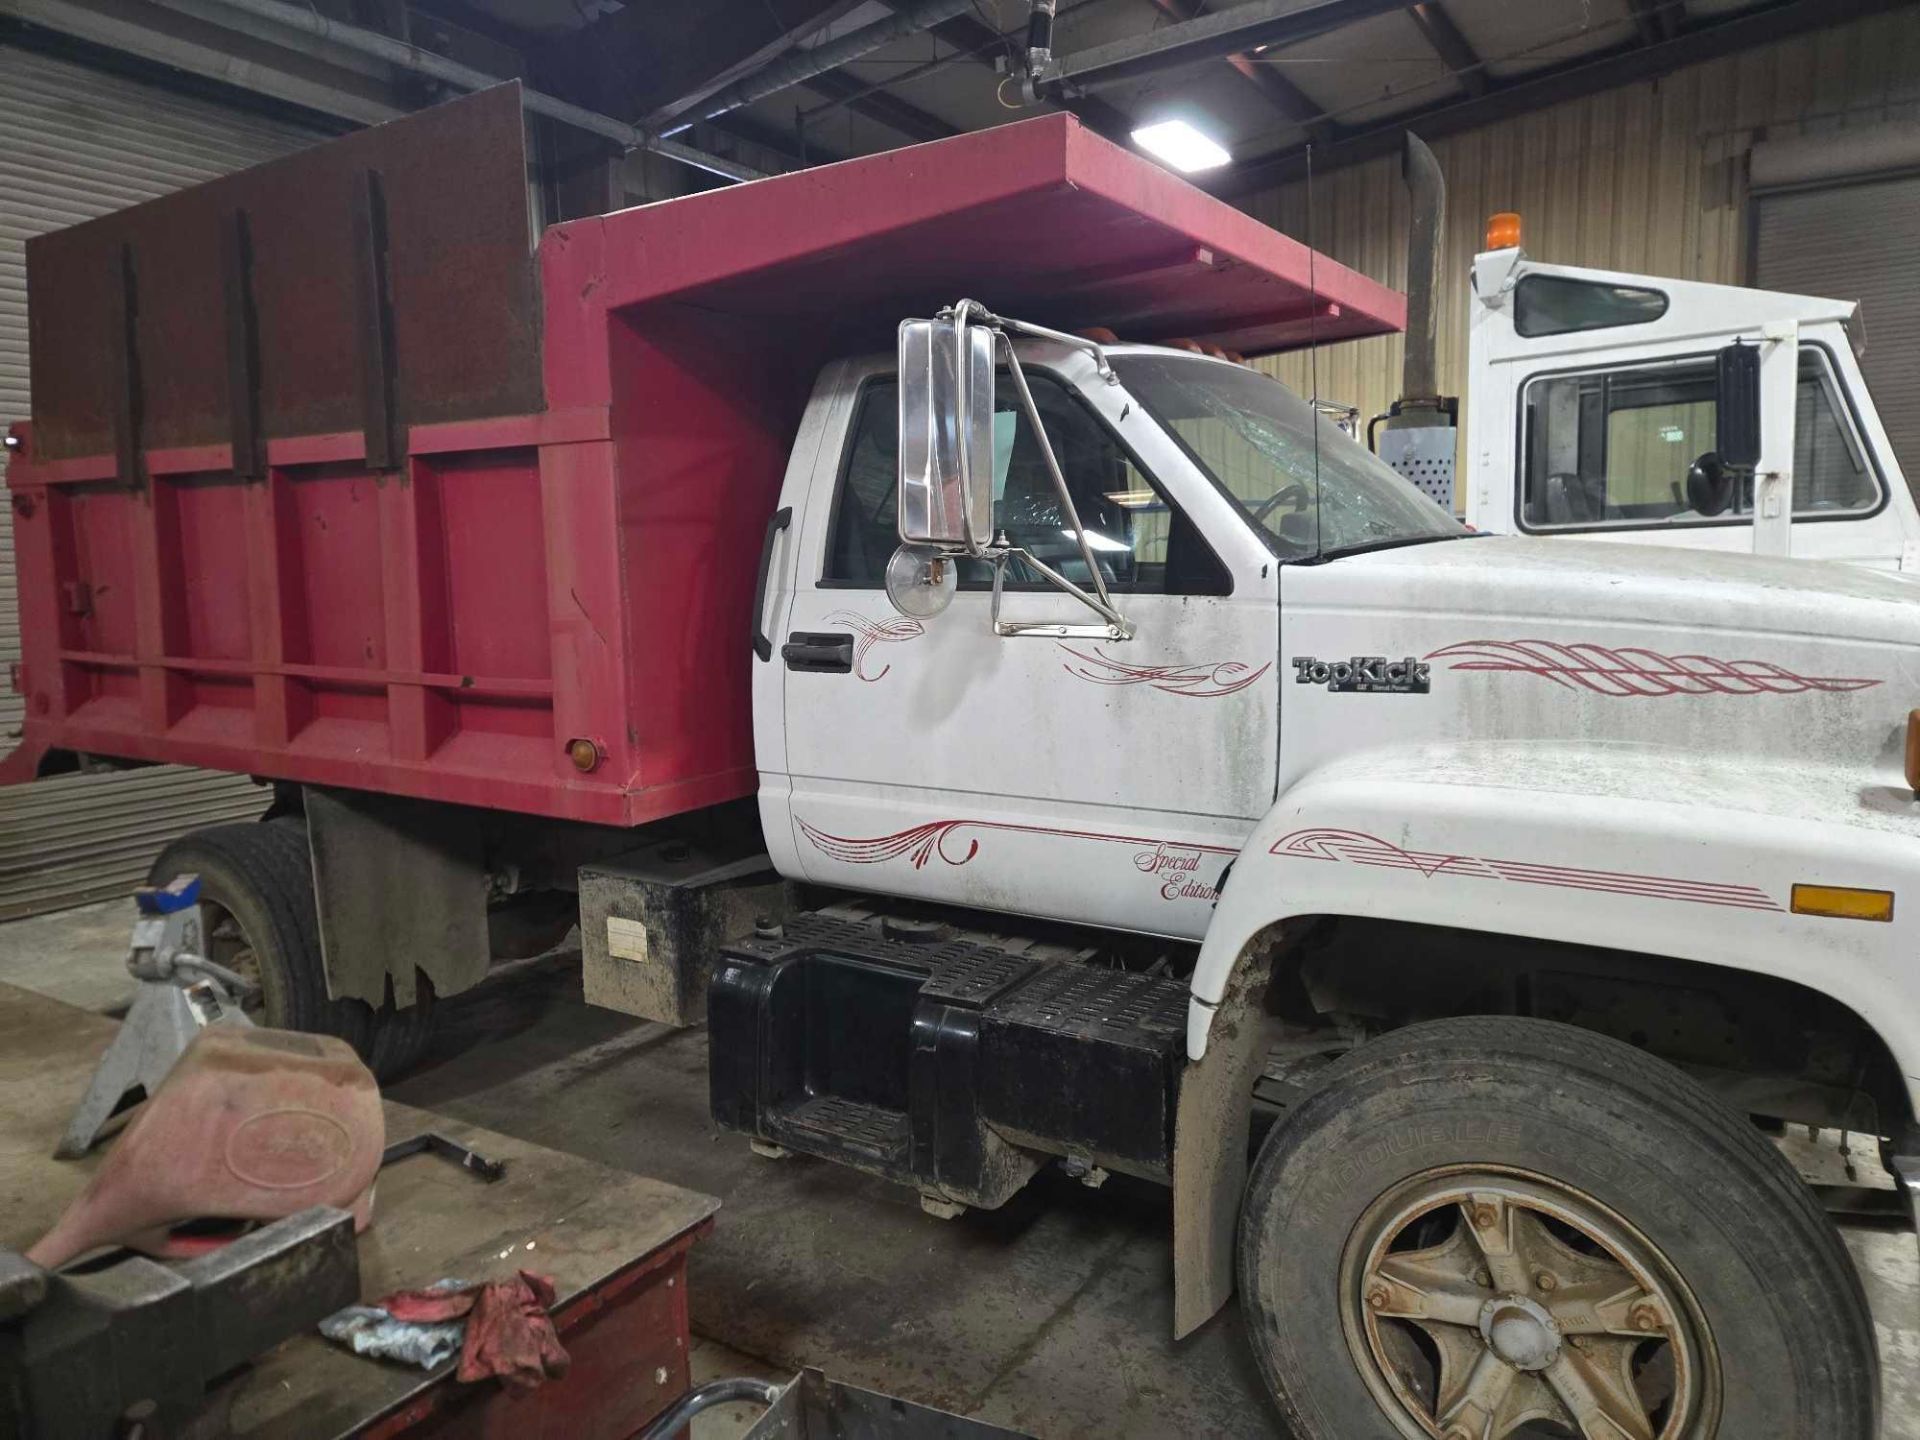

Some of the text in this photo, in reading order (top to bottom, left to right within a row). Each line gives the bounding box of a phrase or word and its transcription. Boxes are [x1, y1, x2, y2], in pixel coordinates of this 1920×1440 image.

[1292, 656, 1430, 692] TopKick
[1134, 842, 1202, 874] Special
[1161, 872, 1220, 901] Edition
